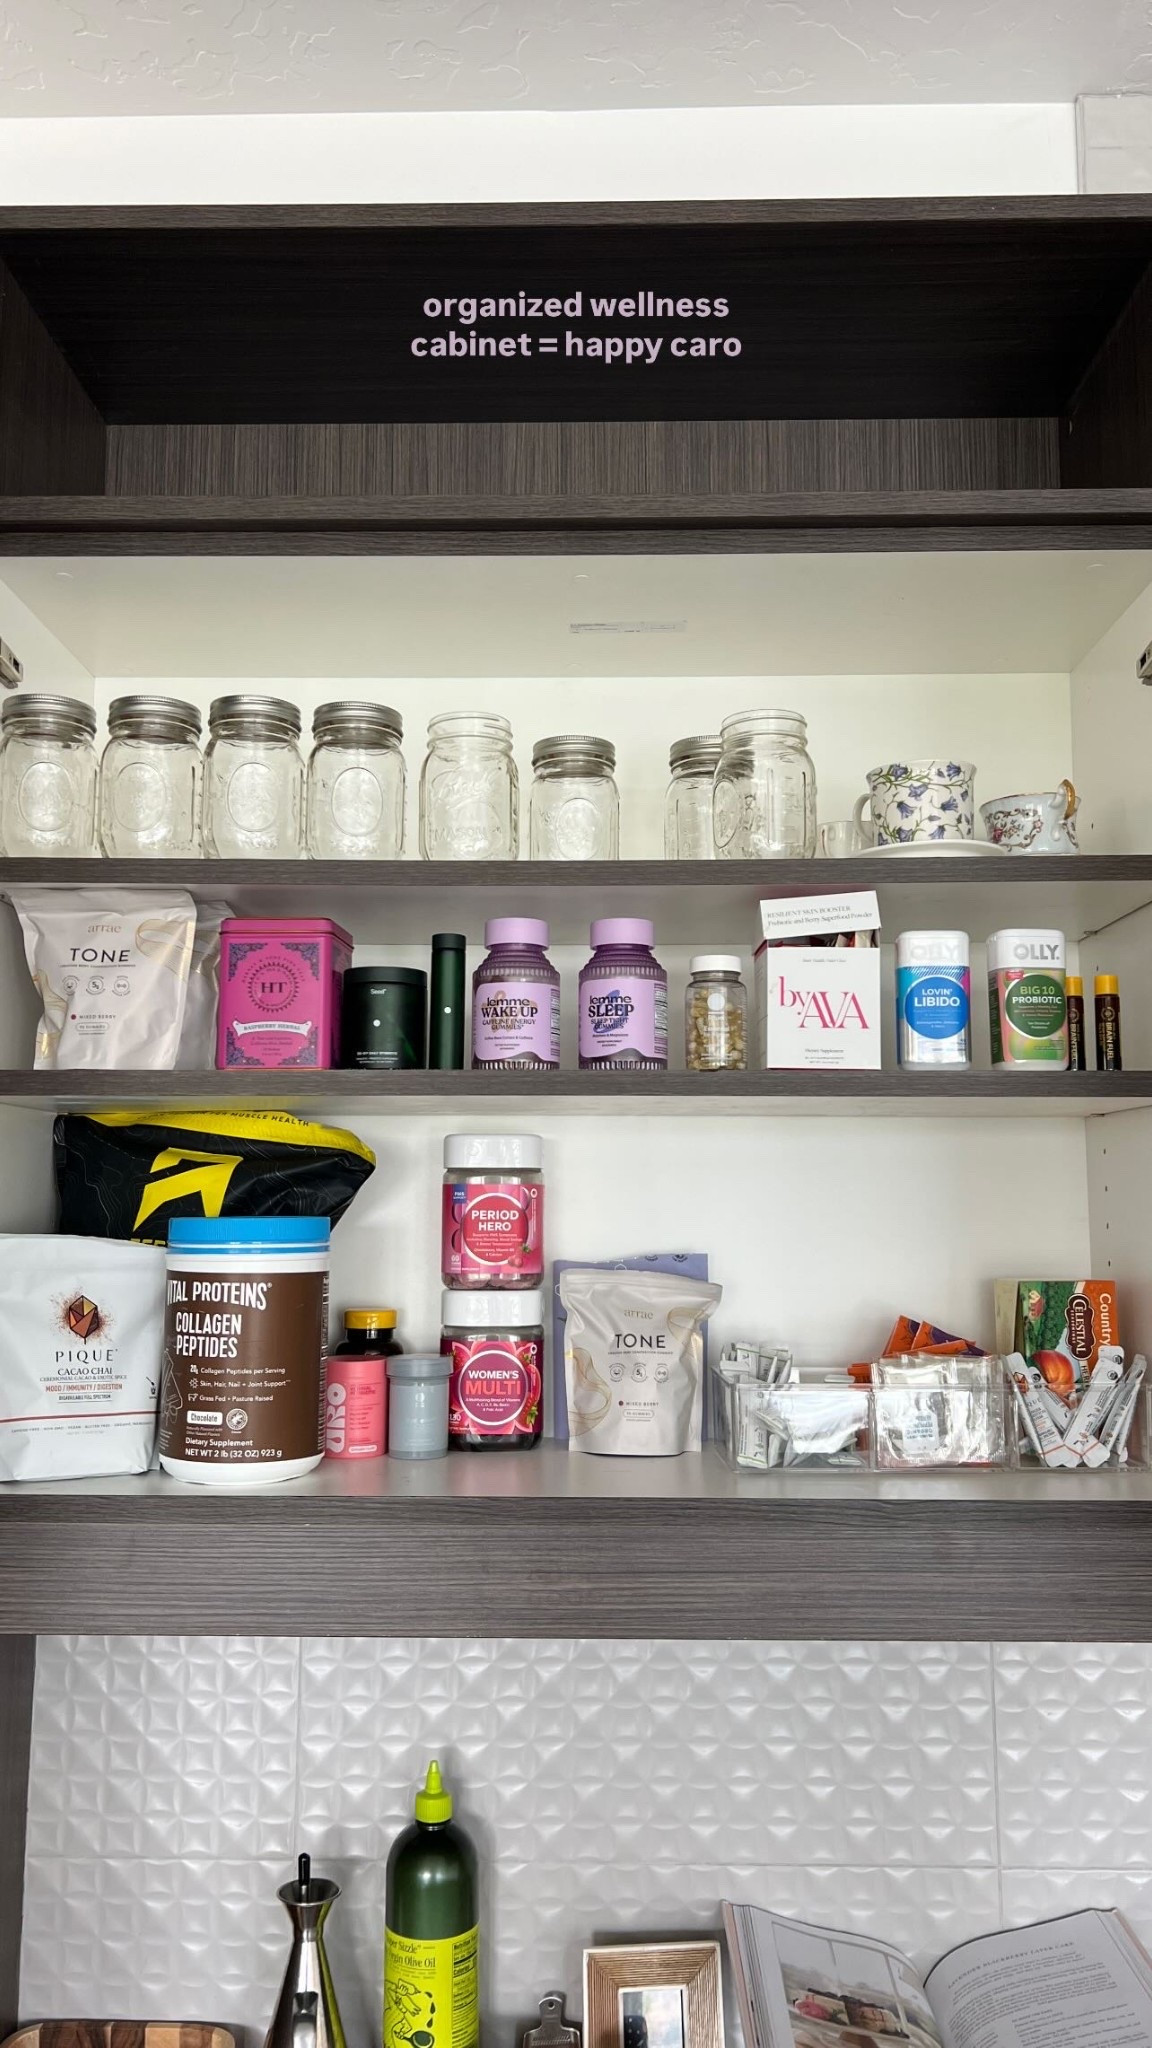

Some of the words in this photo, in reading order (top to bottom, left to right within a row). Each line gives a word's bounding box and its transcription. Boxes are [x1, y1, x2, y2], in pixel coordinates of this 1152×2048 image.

[819, 905, 851, 914] BOOSTER
[70, 948, 131, 962] TONE
[261, 982, 288, 993] HT
[922, 988, 953, 996] LOVIN'
[1020, 985, 1041, 995] BIG
[1042, 985, 1055, 995] 10
[487, 997, 530, 1007] lemme
[590, 995, 632, 1005] lemme
[914, 997, 961, 1007] LIBIDO
[1012, 996, 1063, 1004] PROBIOTIC
[482, 1006, 517, 1018] WAKE
[520, 1006, 538, 1018] UP
[588, 1004, 635, 1018] SLEEP
[231, 1112, 269, 1121] MUSCLE
[271, 1115, 310, 1127] HEALTH
[471, 1210, 519, 1220] PERIOD
[478, 1221, 511, 1231] HERO
[193, 1281, 267, 1311] PROTEINS
[176, 1312, 242, 1335] COLLAGEN
[1099, 1293, 1113, 1346] Country
[1072, 1299, 1087, 1355] CELESTIAL
[176, 1335, 238, 1358] PEPTIDES
[615, 1333, 666, 1349] TONE
[56, 1350, 114, 1364] PIQUE
[58, 1368, 90, 1376] CACAO
[91, 1367, 113, 1375] CHAI
[200, 1367, 225, 1376] Collagen
[468, 1370, 520, 1379] WOMEN'S
[66, 1384, 93, 1392] IMMUNITY
[97, 1383, 123, 1391] DIGESTION
[465, 1380, 521, 1395] MULTI
[190, 1413, 218, 1422] Chocolate
[185, 1437, 209, 1447] Dietary
[209, 1439, 253, 1448] Supplement
[185, 1448, 199, 1456] NET
[200, 1449, 212, 1457] WT
[213, 1450, 219, 1458] 2
[229, 1450, 243, 1459] (32
[244, 1450, 260, 1458] OZ)
[260, 1448, 275, 1457] 923
[277, 1449, 282, 1457] g
[404, 1954, 423, 1968] Olive
[424, 1956, 436, 1968] Oil
